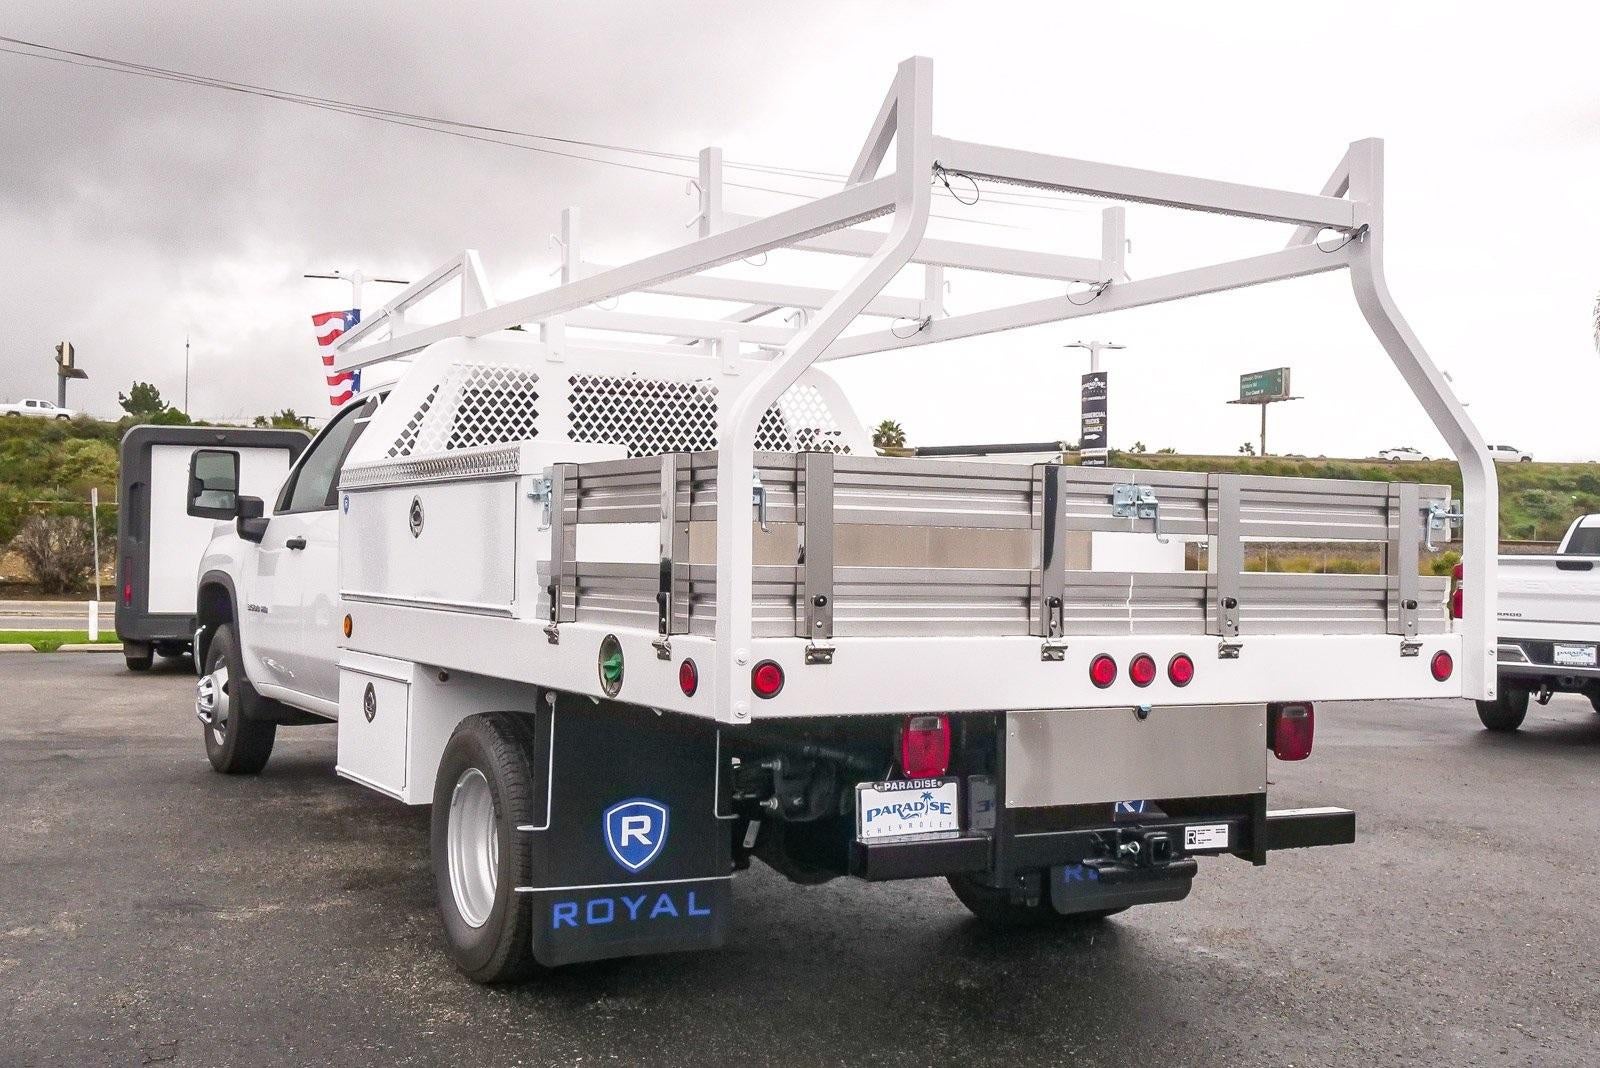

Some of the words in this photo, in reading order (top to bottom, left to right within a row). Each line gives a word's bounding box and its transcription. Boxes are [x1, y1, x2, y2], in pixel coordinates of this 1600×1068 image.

[884, 780, 937, 791] PARADISE
[866, 801, 952, 822] PARADISE
[620, 815, 653, 847] R
[866, 822, 952, 837] CHEVROLET
[552, 892, 711, 929] ROYAL
